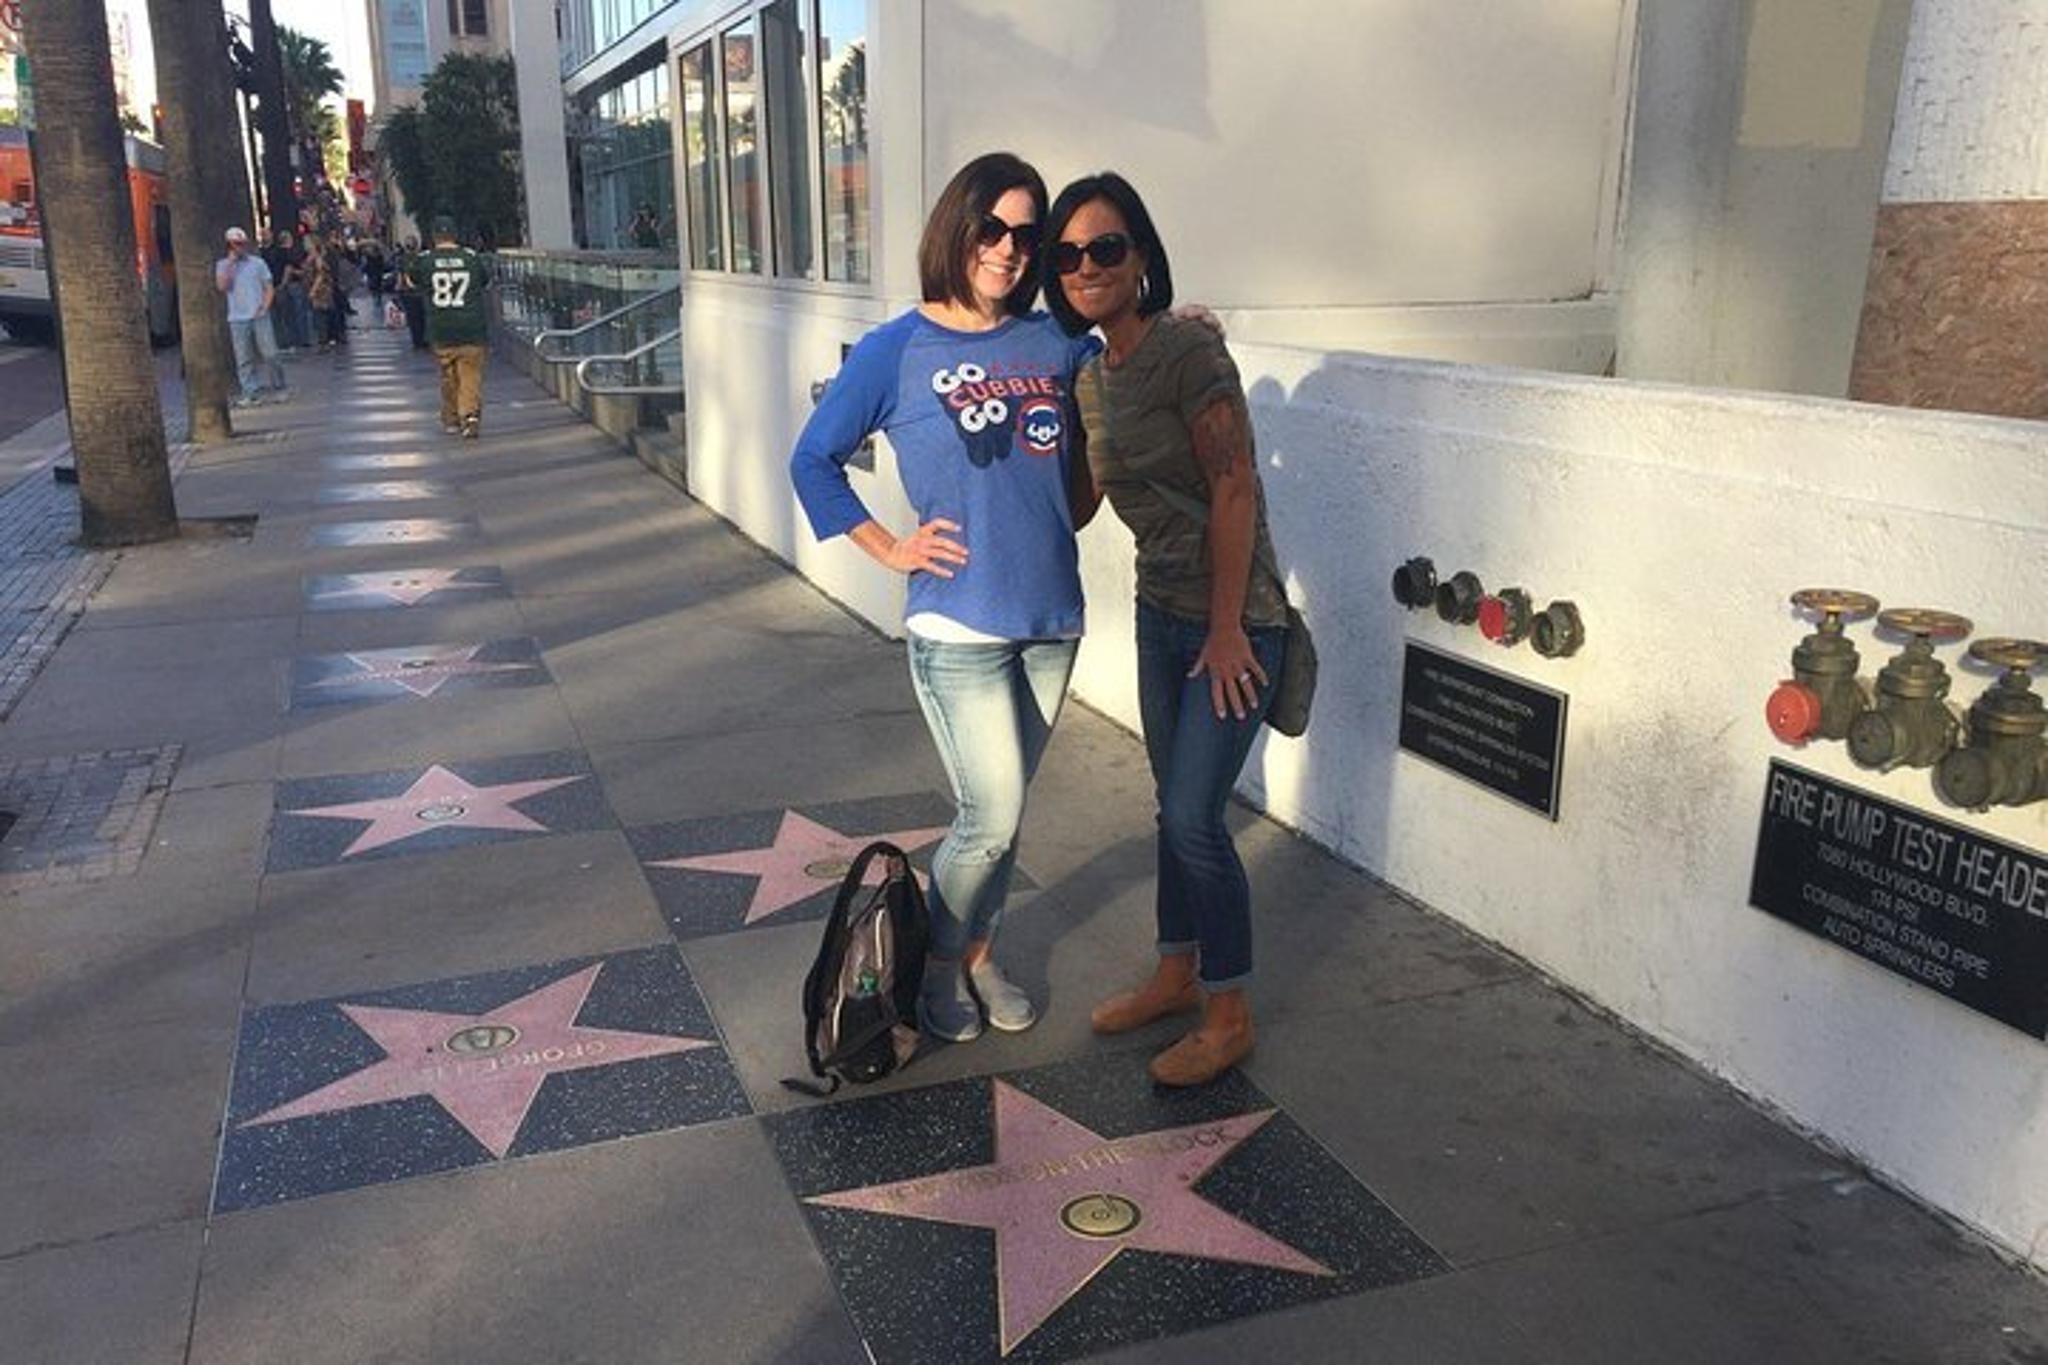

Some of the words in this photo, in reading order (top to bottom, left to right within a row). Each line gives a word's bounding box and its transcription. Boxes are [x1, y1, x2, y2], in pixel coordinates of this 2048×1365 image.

[432, 272, 470, 308] 87
[932, 362, 986, 394] GO
[960, 398, 1008, 433] GO
[1768, 771, 1819, 826] FIRE
[1819, 790, 1887, 849] PUMP
[1890, 816, 1955, 877] TEST
[1953, 841, 2048, 918] HEADE
[1849, 854, 1943, 906] HOLLYWOOD
[1802, 883, 1898, 936] COMBINATION
[1899, 924, 1949, 960] STAND
[1951, 947, 1991, 980] PIPE
[1823, 915, 1862, 945] AUTO
[1863, 932, 1956, 989] SPRINKLERS
